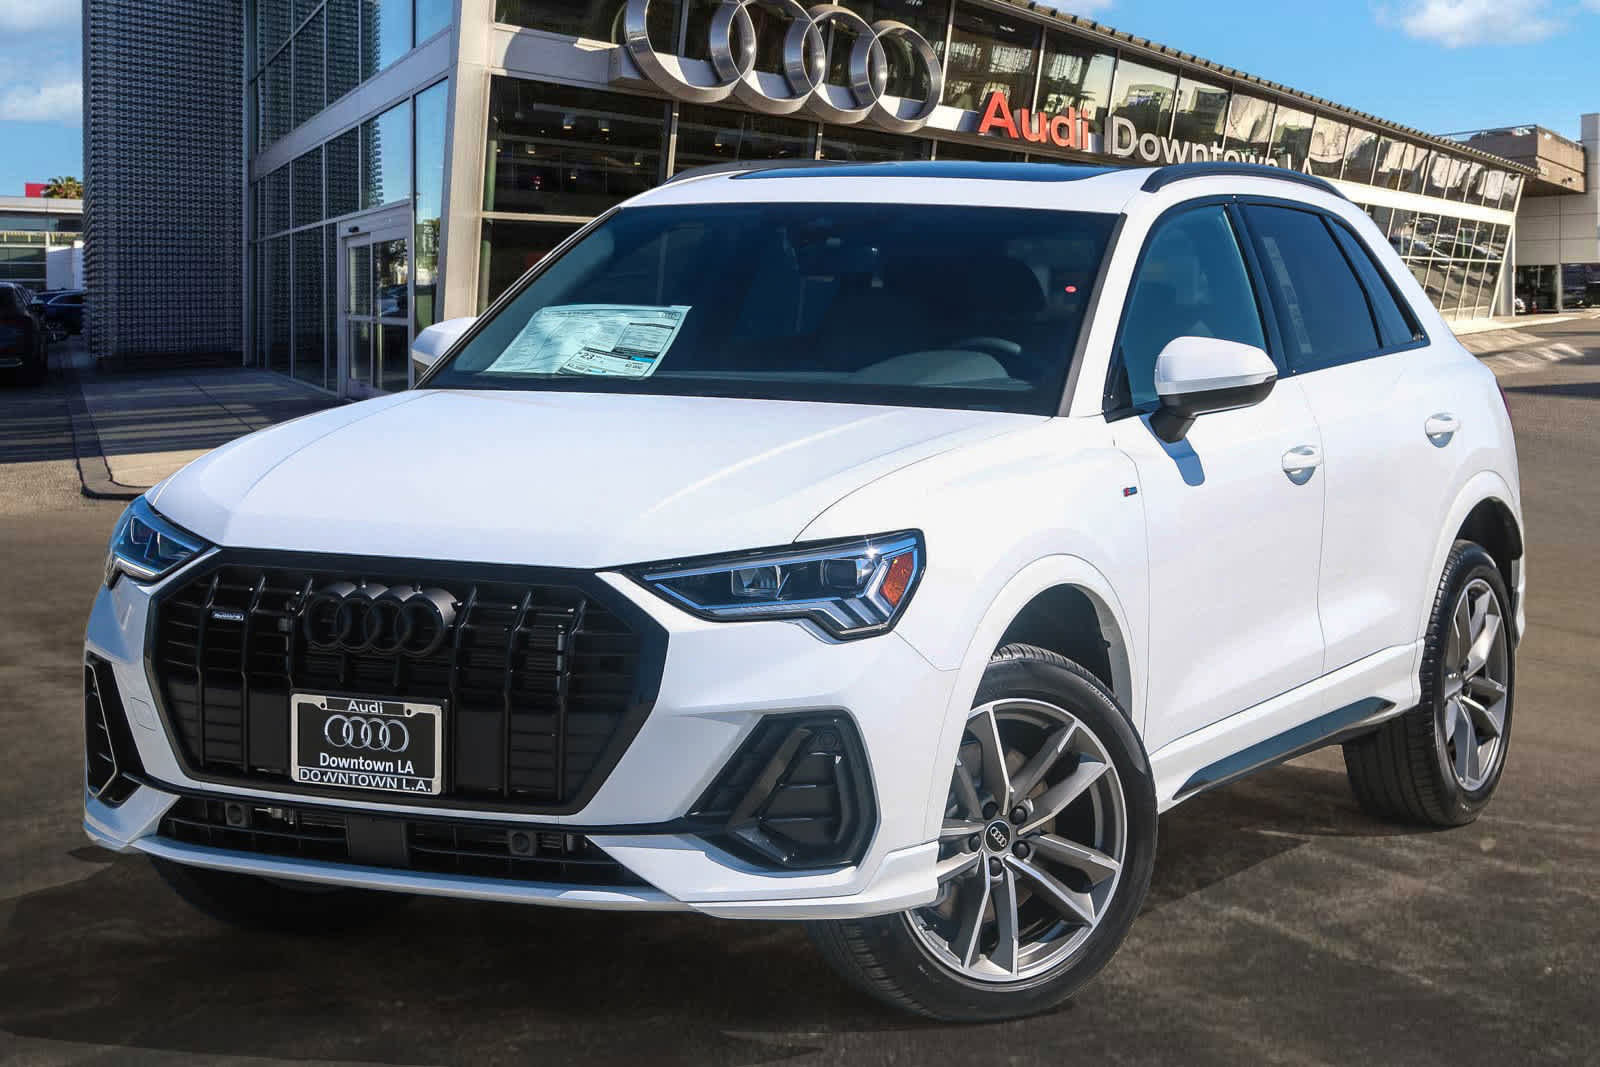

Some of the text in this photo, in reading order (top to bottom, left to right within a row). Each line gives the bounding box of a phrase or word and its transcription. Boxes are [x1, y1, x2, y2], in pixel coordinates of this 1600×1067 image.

[978, 91, 1089, 151] Audi
[347, 700, 383, 714] Audi
[319, 752, 415, 775] Downtown LA
[300, 768, 431, 793] DOWNTOWN L.A.
